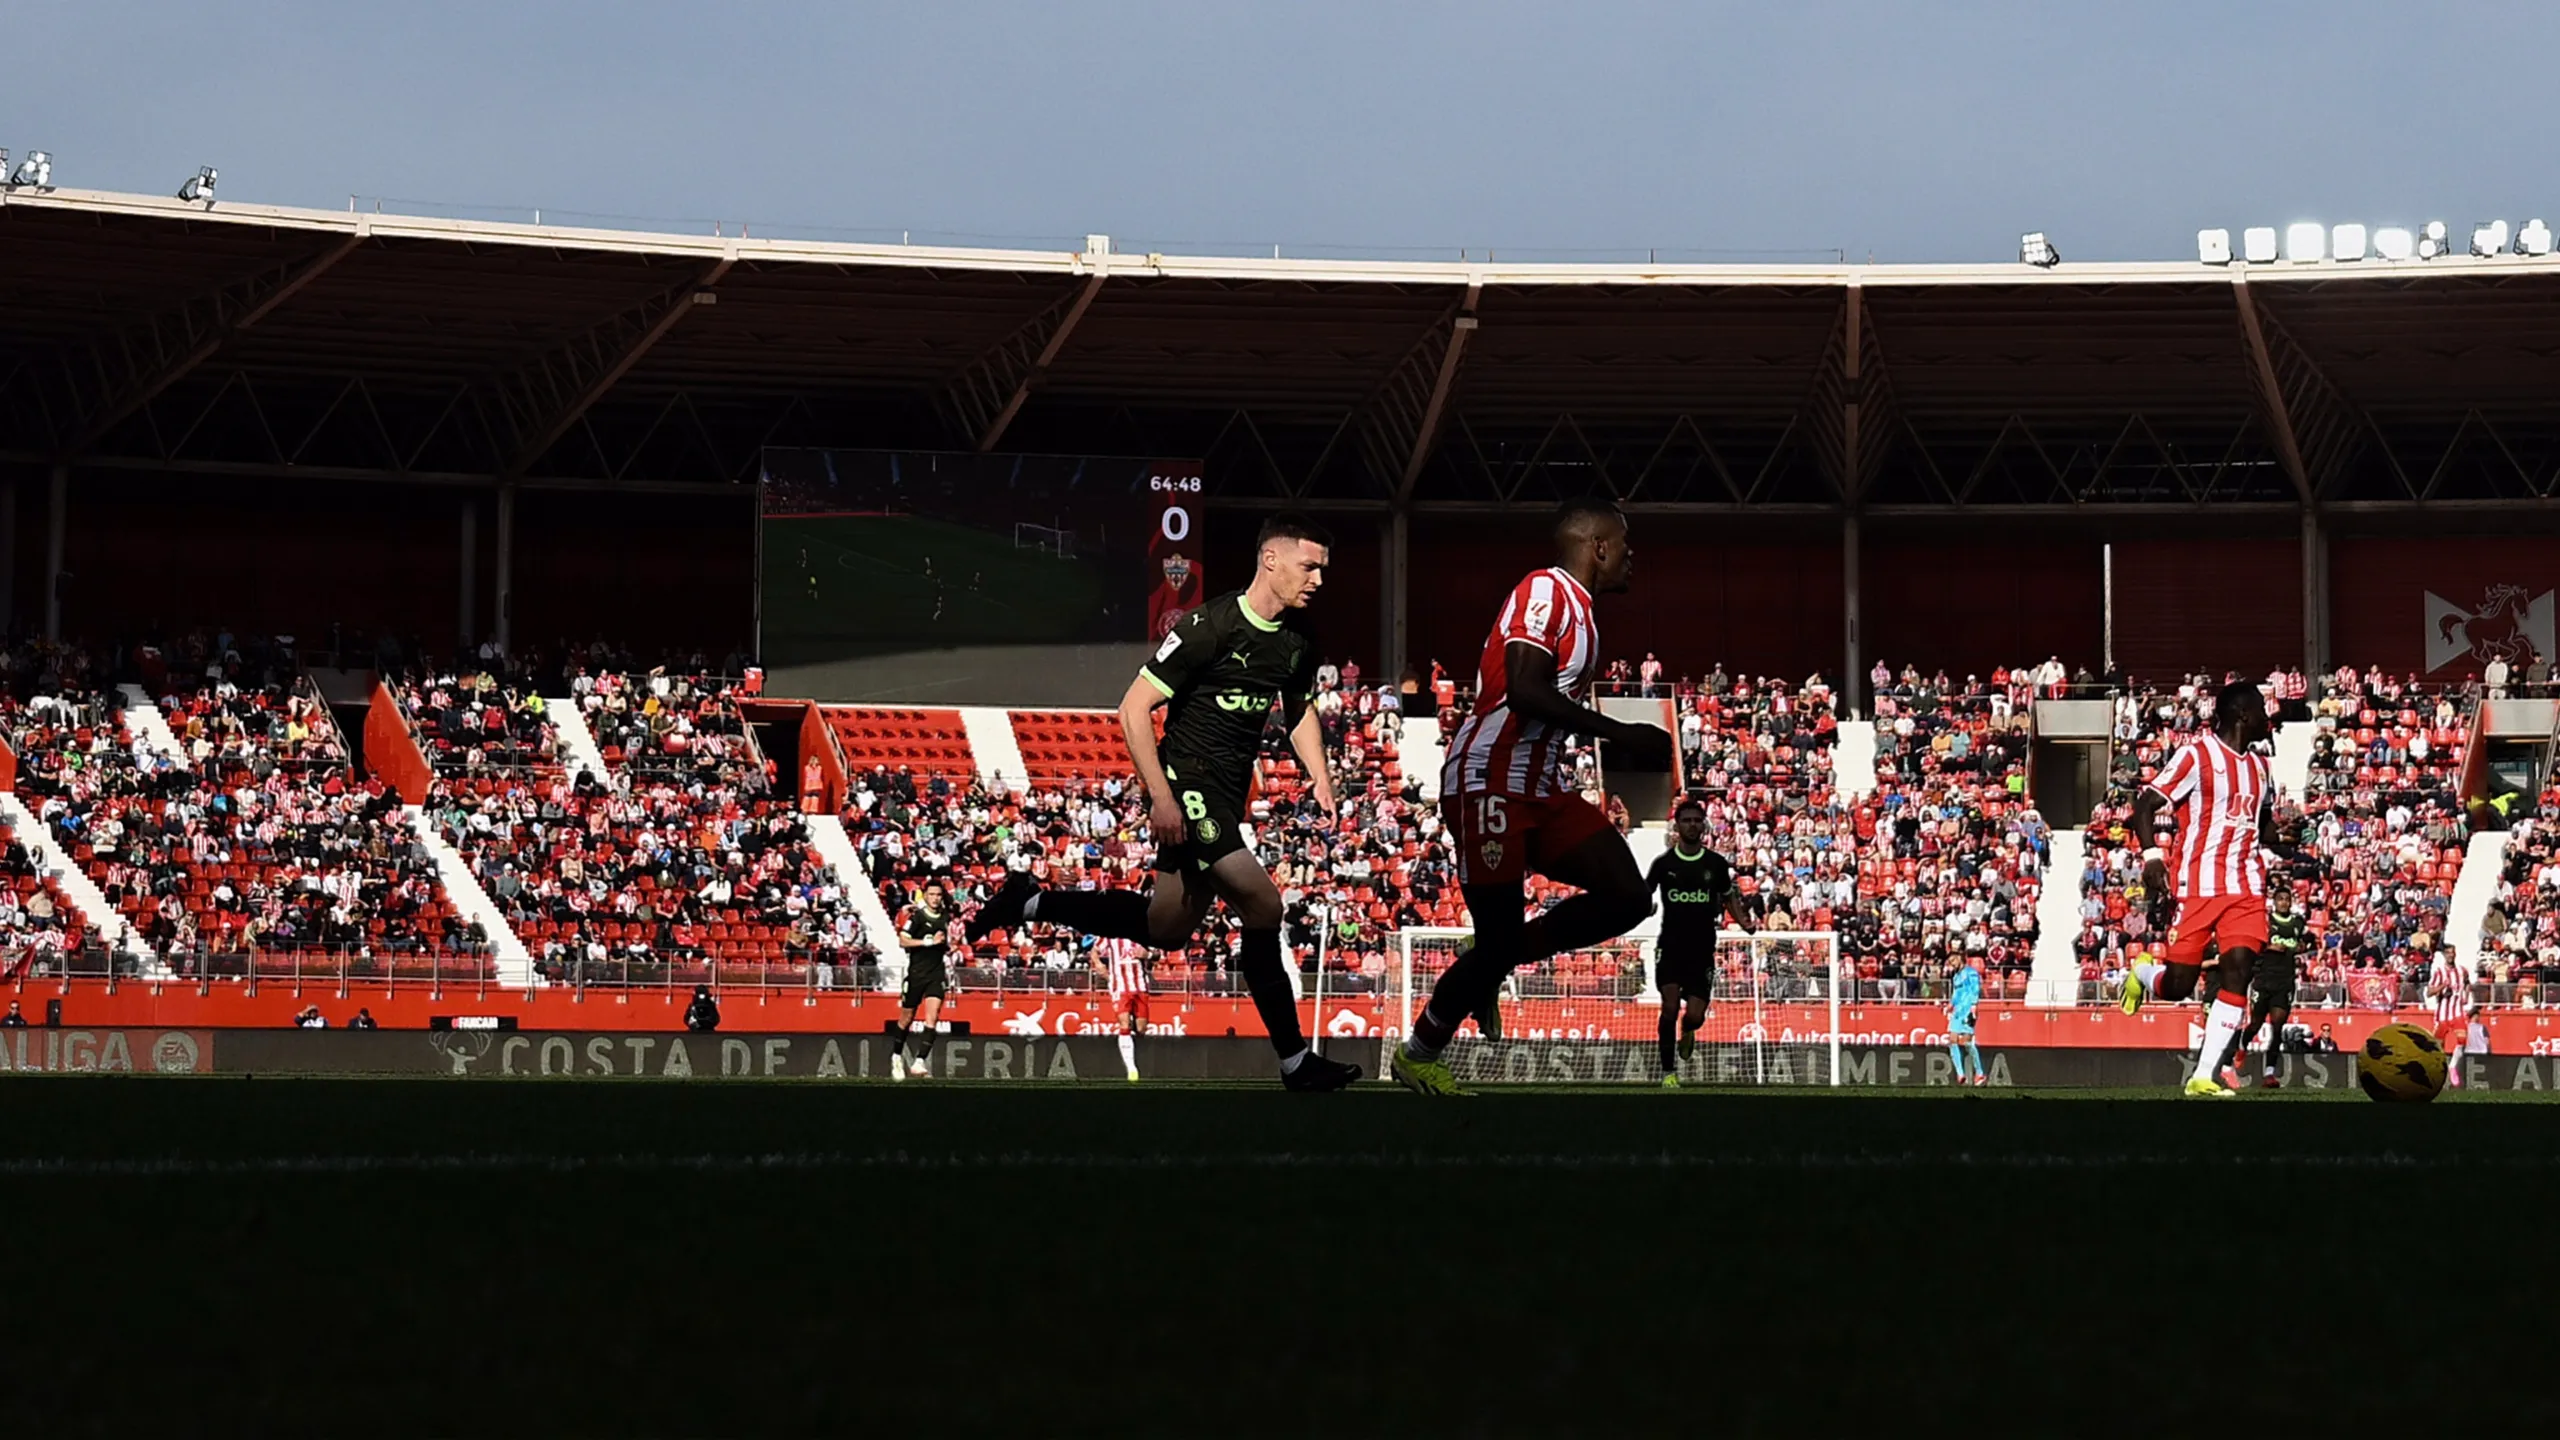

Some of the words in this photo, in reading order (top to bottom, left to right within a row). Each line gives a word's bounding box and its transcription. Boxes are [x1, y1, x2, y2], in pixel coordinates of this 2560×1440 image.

[1149, 476, 1201, 492] 64:48
[1161, 506, 1190, 541] 0
[1182, 789, 1208, 821] 8
[1473, 794, 1508, 835] 15
[1667, 887, 1710, 903] Gosbi
[1055, 1011, 1188, 1036] Caixaank
[1780, 1027, 1905, 1046] Automotor
[502, 1036, 692, 1076] COSTA
